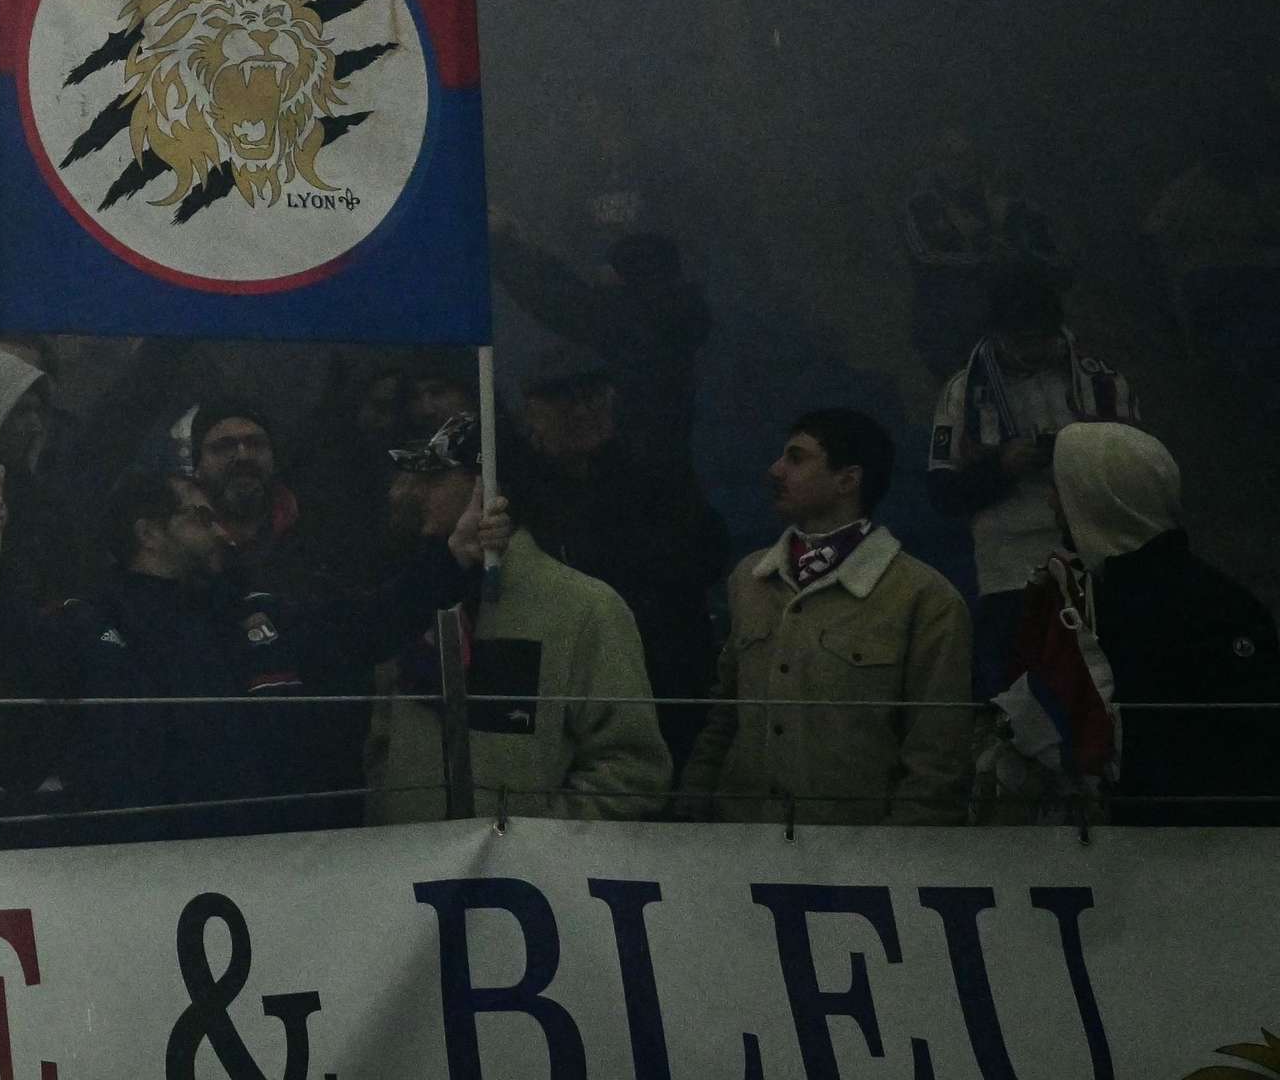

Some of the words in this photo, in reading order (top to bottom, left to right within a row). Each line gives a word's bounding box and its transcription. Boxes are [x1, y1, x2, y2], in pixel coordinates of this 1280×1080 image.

[286, 191, 337, 210] LYON
[165, 891, 337, 1080] &
[412, 877, 1116, 1080] BLEU
